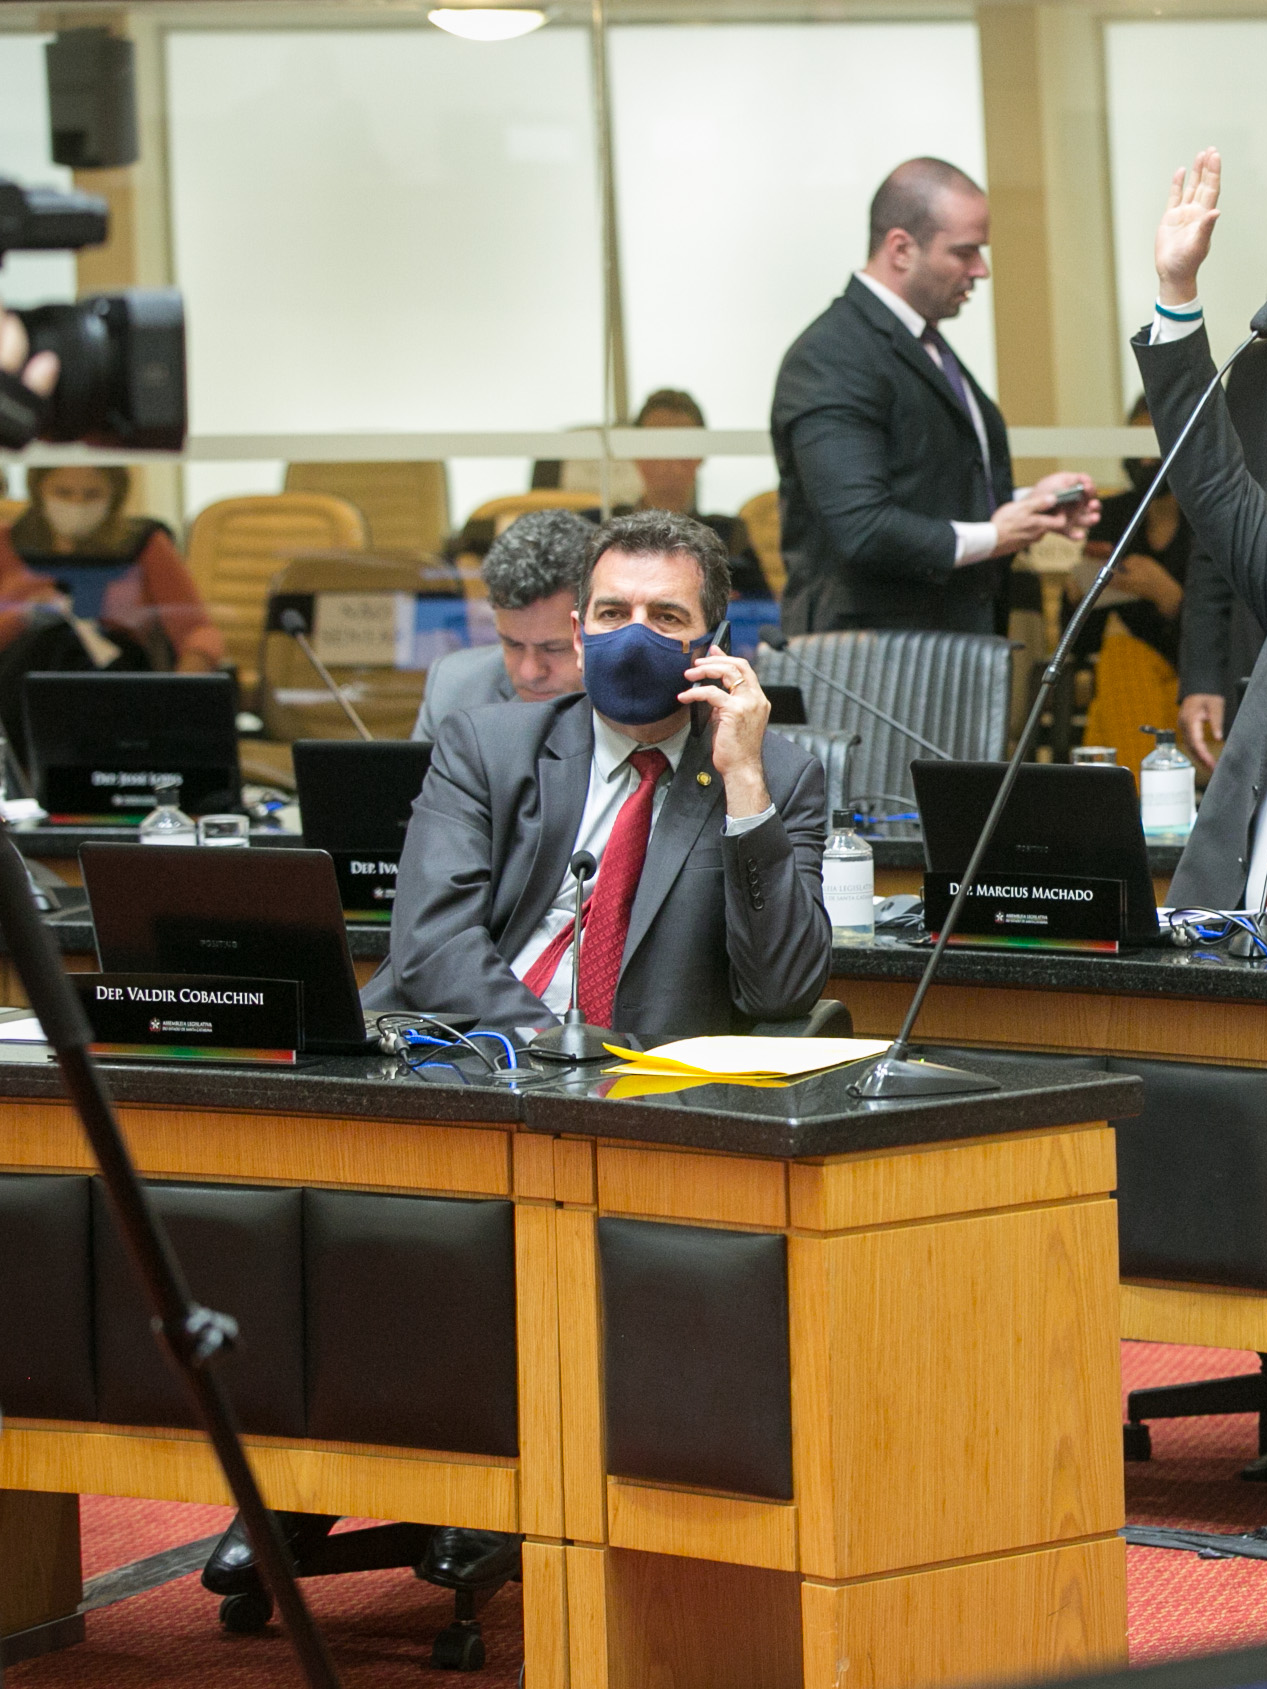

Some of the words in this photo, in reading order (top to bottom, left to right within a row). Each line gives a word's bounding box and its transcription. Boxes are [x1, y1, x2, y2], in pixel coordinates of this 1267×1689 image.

[350, 860, 376, 874] DEP.
[976, 884, 1028, 899] MARCIUS
[1031, 886, 1094, 901] MACHADO
[96, 985, 124, 1000] DEP.
[127, 986, 177, 1002] VALDIR
[179, 988, 264, 1005] COBALCHINI
